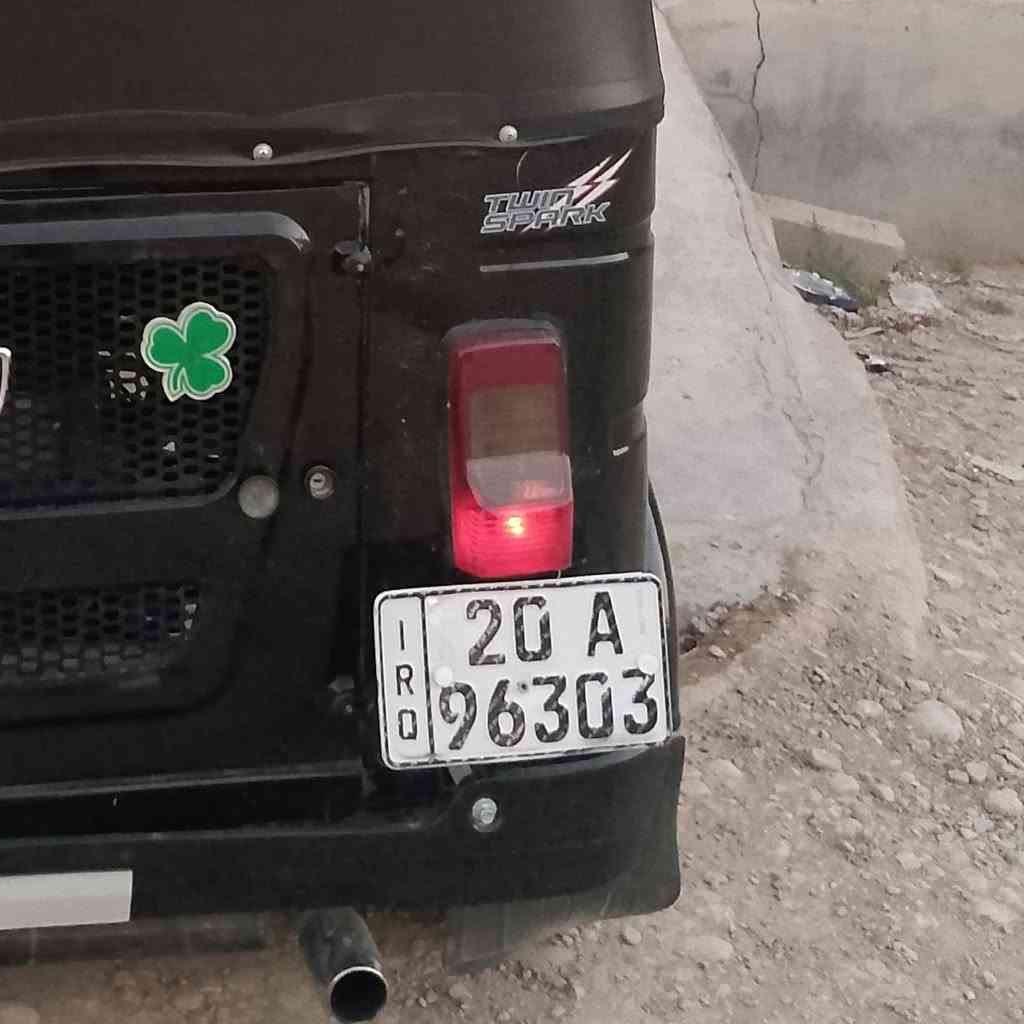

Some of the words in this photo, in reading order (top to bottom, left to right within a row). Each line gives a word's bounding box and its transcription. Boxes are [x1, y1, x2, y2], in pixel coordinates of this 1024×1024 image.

[480, 202, 611, 234] SPARK
[483, 188, 577, 214] TWIN
[466, 595, 554, 666] 20
[587, 591, 624, 657] A
[438, 668, 659, 751] 96303
